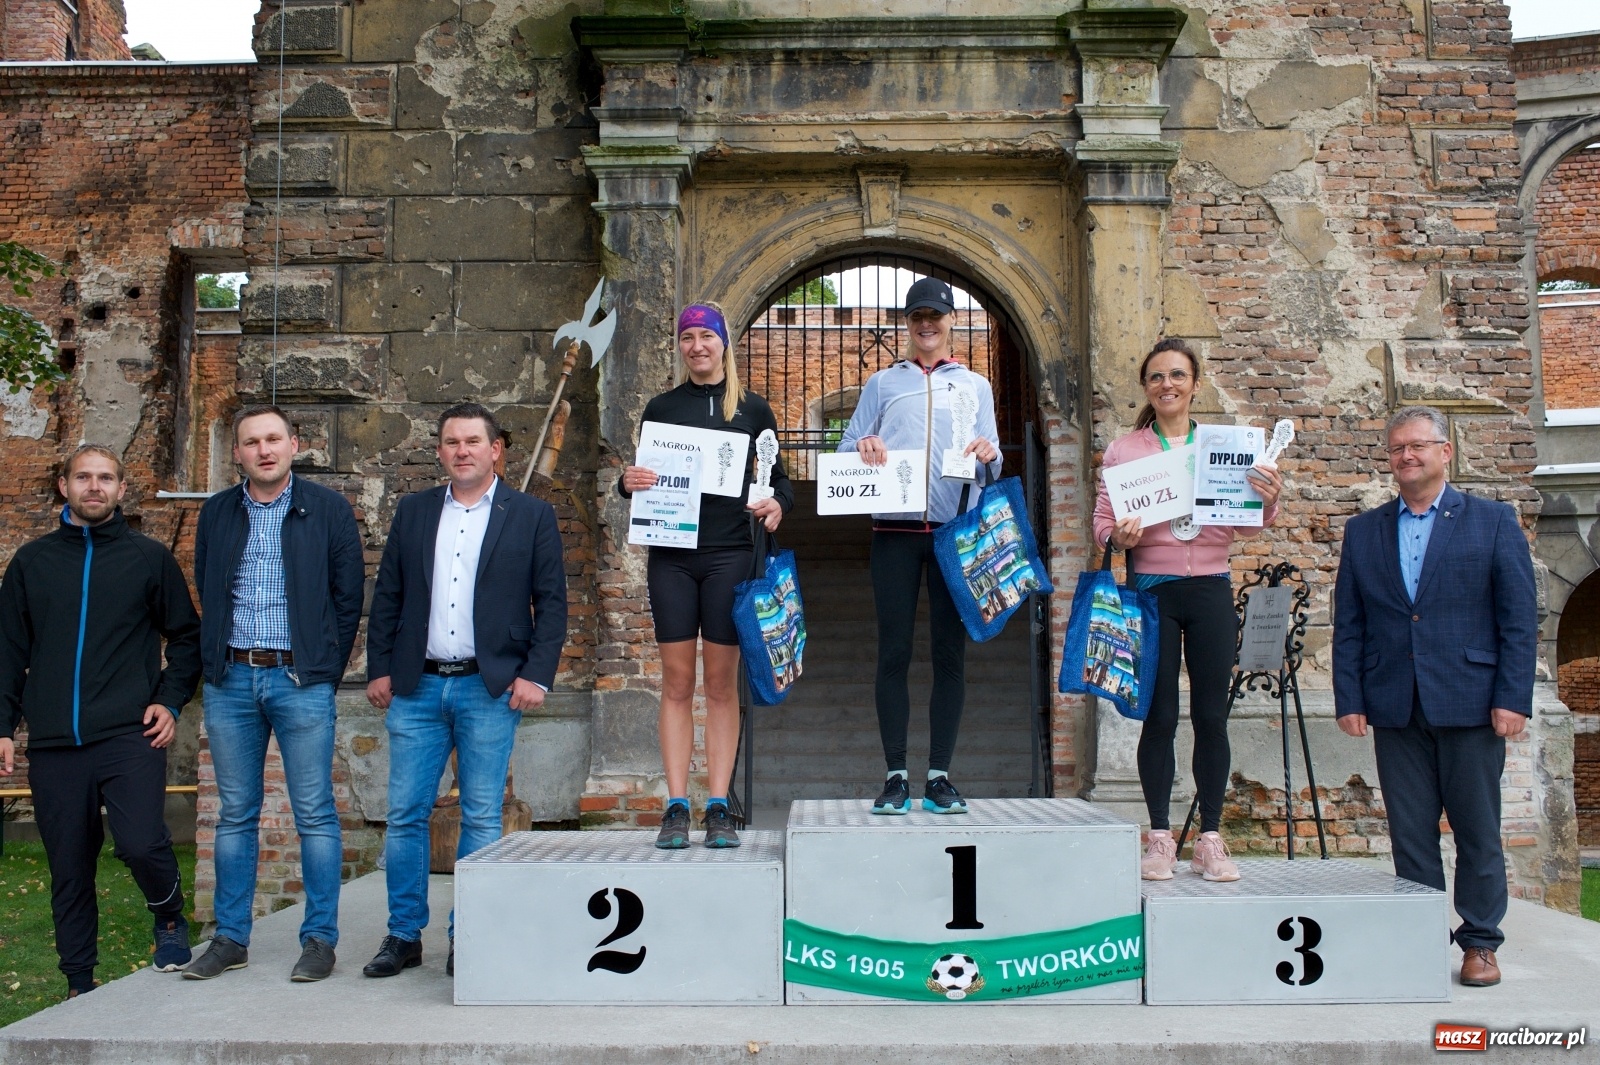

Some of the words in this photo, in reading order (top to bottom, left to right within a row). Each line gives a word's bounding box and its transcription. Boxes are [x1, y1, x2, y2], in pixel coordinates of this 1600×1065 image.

[652, 440, 702, 452] NAGRODA
[1209, 452, 1254, 466] DYPLOM
[653, 474, 690, 489] YPLOM
[830, 468, 880, 477] NAGRODA
[1119, 471, 1171, 491] NAGRODA
[827, 485, 855, 498] 300
[859, 484, 882, 497] ZŁ
[1123, 495, 1151, 513] 100
[1154, 487, 1178, 504] ZŁ
[1213, 500, 1245, 508] 19.09.2021
[649, 520, 680, 529] 19.09.2021
[945, 845, 984, 930] 1
[587, 887, 646, 975] 2
[785, 940, 837, 969] LKS
[846, 954, 905, 980] 1905
[996, 936, 1141, 980] TWORKÓW
[1276, 916, 1324, 986] 3
[1016, 978, 1050, 994] przekór
[1074, 975, 1084, 983] co
